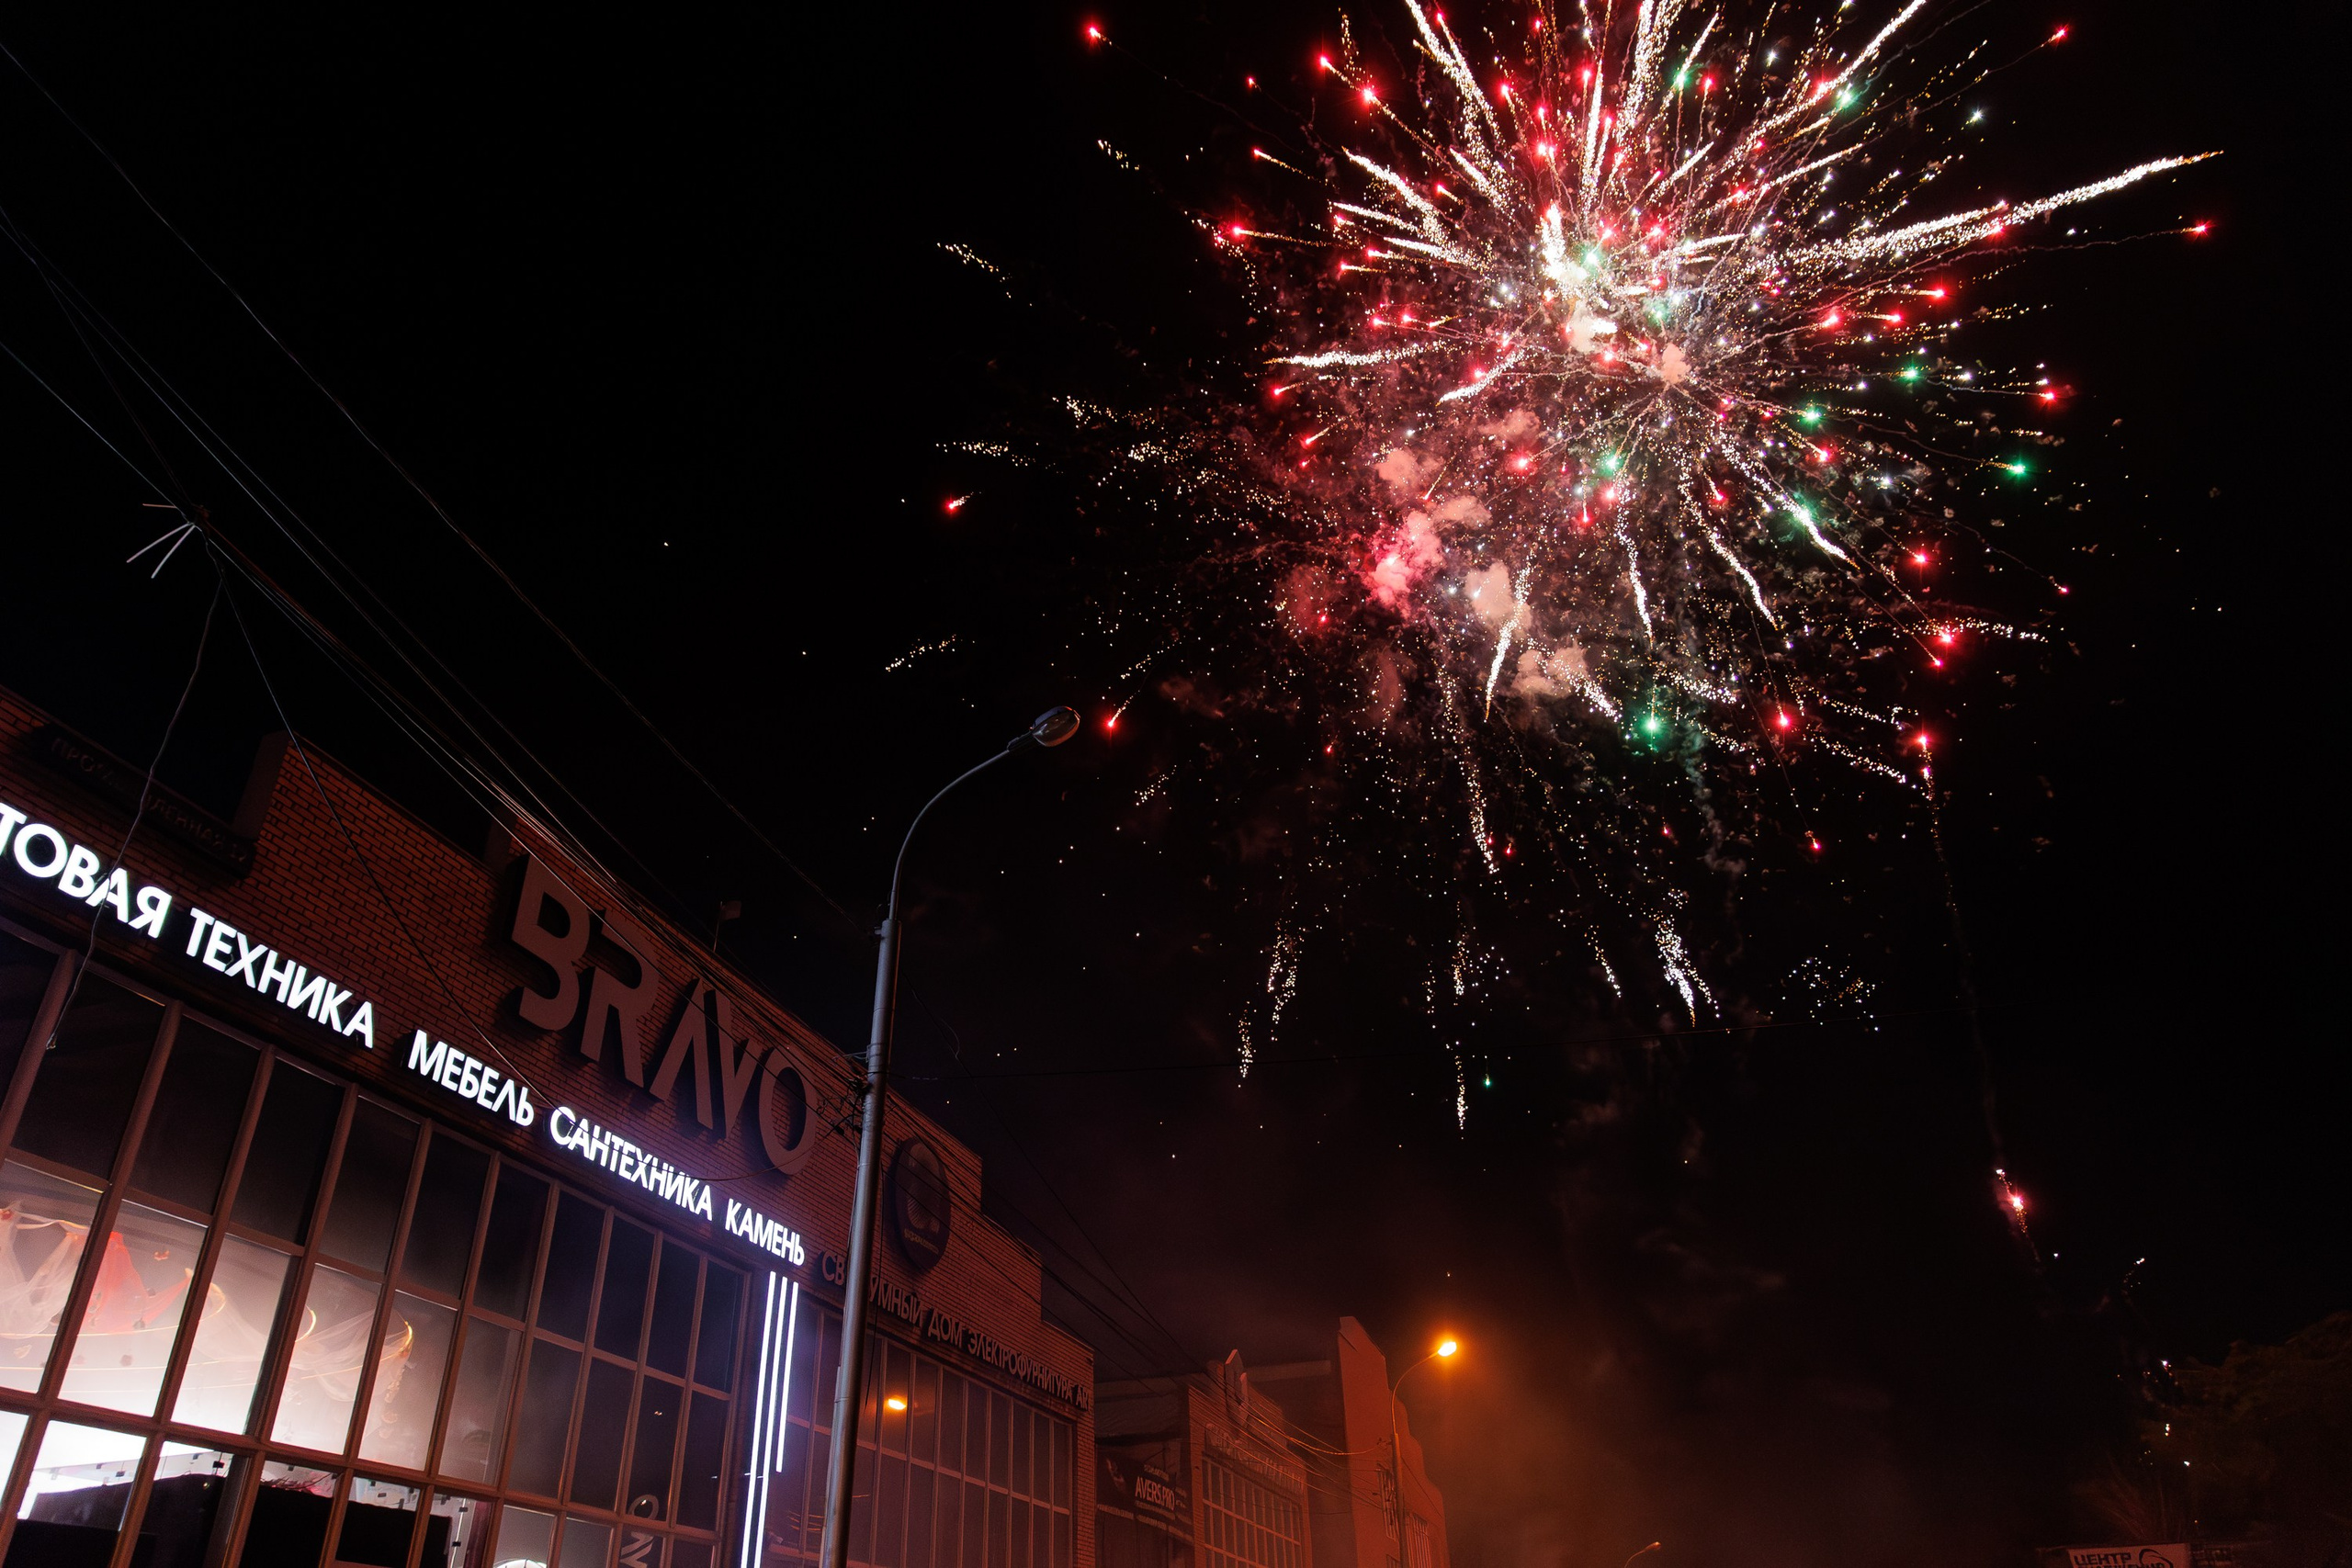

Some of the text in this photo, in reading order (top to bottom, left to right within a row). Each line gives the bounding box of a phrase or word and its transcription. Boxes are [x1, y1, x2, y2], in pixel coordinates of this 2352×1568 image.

[0, 803, 805, 1266] ТОВАЯ ТЕХНИКА МЕБЕЛЬ САНТЕХНИКА КАМЕНЬ
[511, 855, 820, 1175] BRAVO
[869, 1276, 923, 1328] УМНЫЙ
[927, 1308, 963, 1348] ДОМ
[967, 1329, 1073, 1404] ЭЛЕКТРОФУРНИТУРА
[2074, 1552, 2132, 1565] ЦЕНТР
